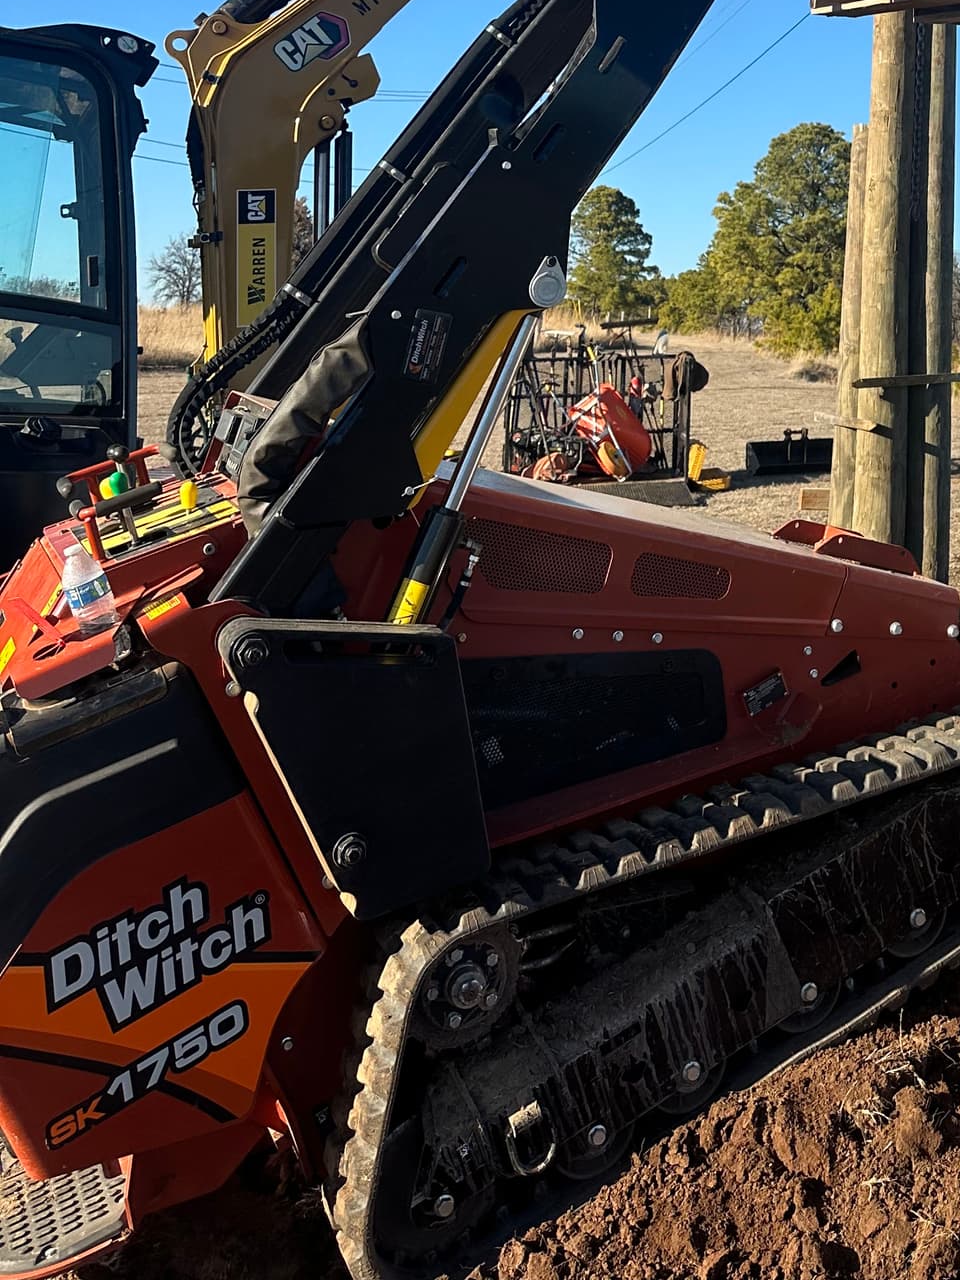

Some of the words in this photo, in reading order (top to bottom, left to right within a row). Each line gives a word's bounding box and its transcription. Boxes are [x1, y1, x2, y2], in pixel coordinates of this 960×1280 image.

[274, 16, 335, 70] CAT
[247, 192, 266, 221] CAT
[247, 238, 266, 305] WARREN
[50, 885, 205, 1004] Ditch
[50, 1096, 106, 1145] SK
[107, 1004, 245, 1103] 1750
